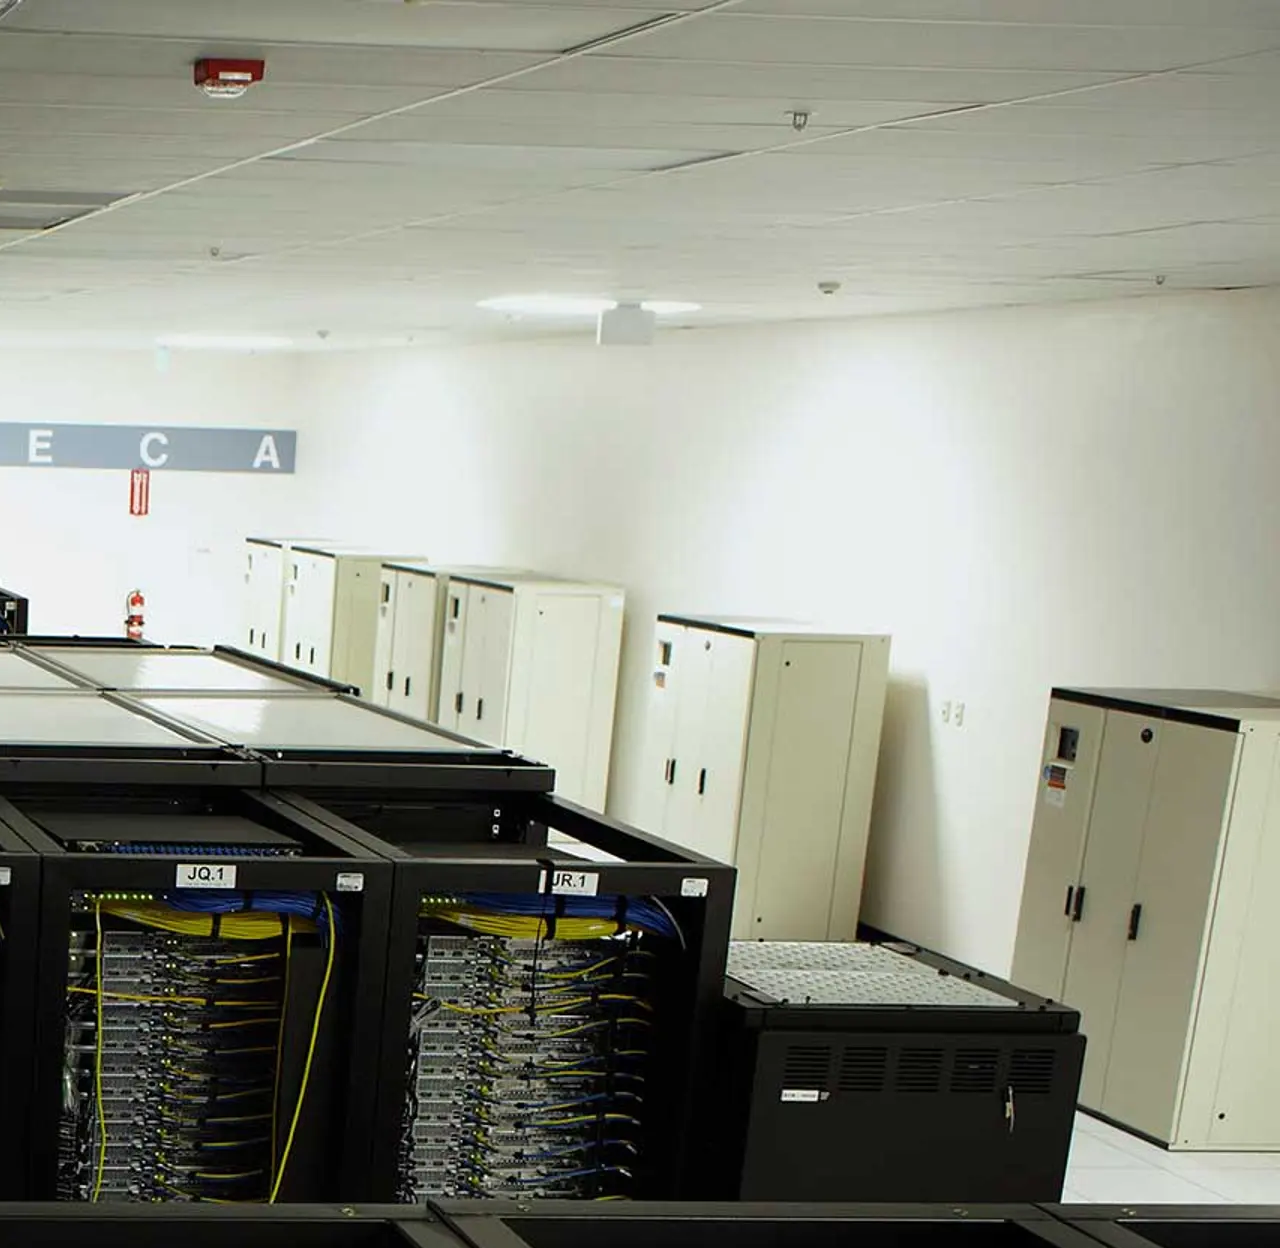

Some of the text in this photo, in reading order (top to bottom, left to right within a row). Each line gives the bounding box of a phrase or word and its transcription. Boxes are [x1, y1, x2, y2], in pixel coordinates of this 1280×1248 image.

[28, 429, 54, 463] E
[139, 431, 169, 467] C
[251, 434, 281, 469] A
[187, 866, 224, 882] JQ.1
[552, 873, 586, 888] JR.1
